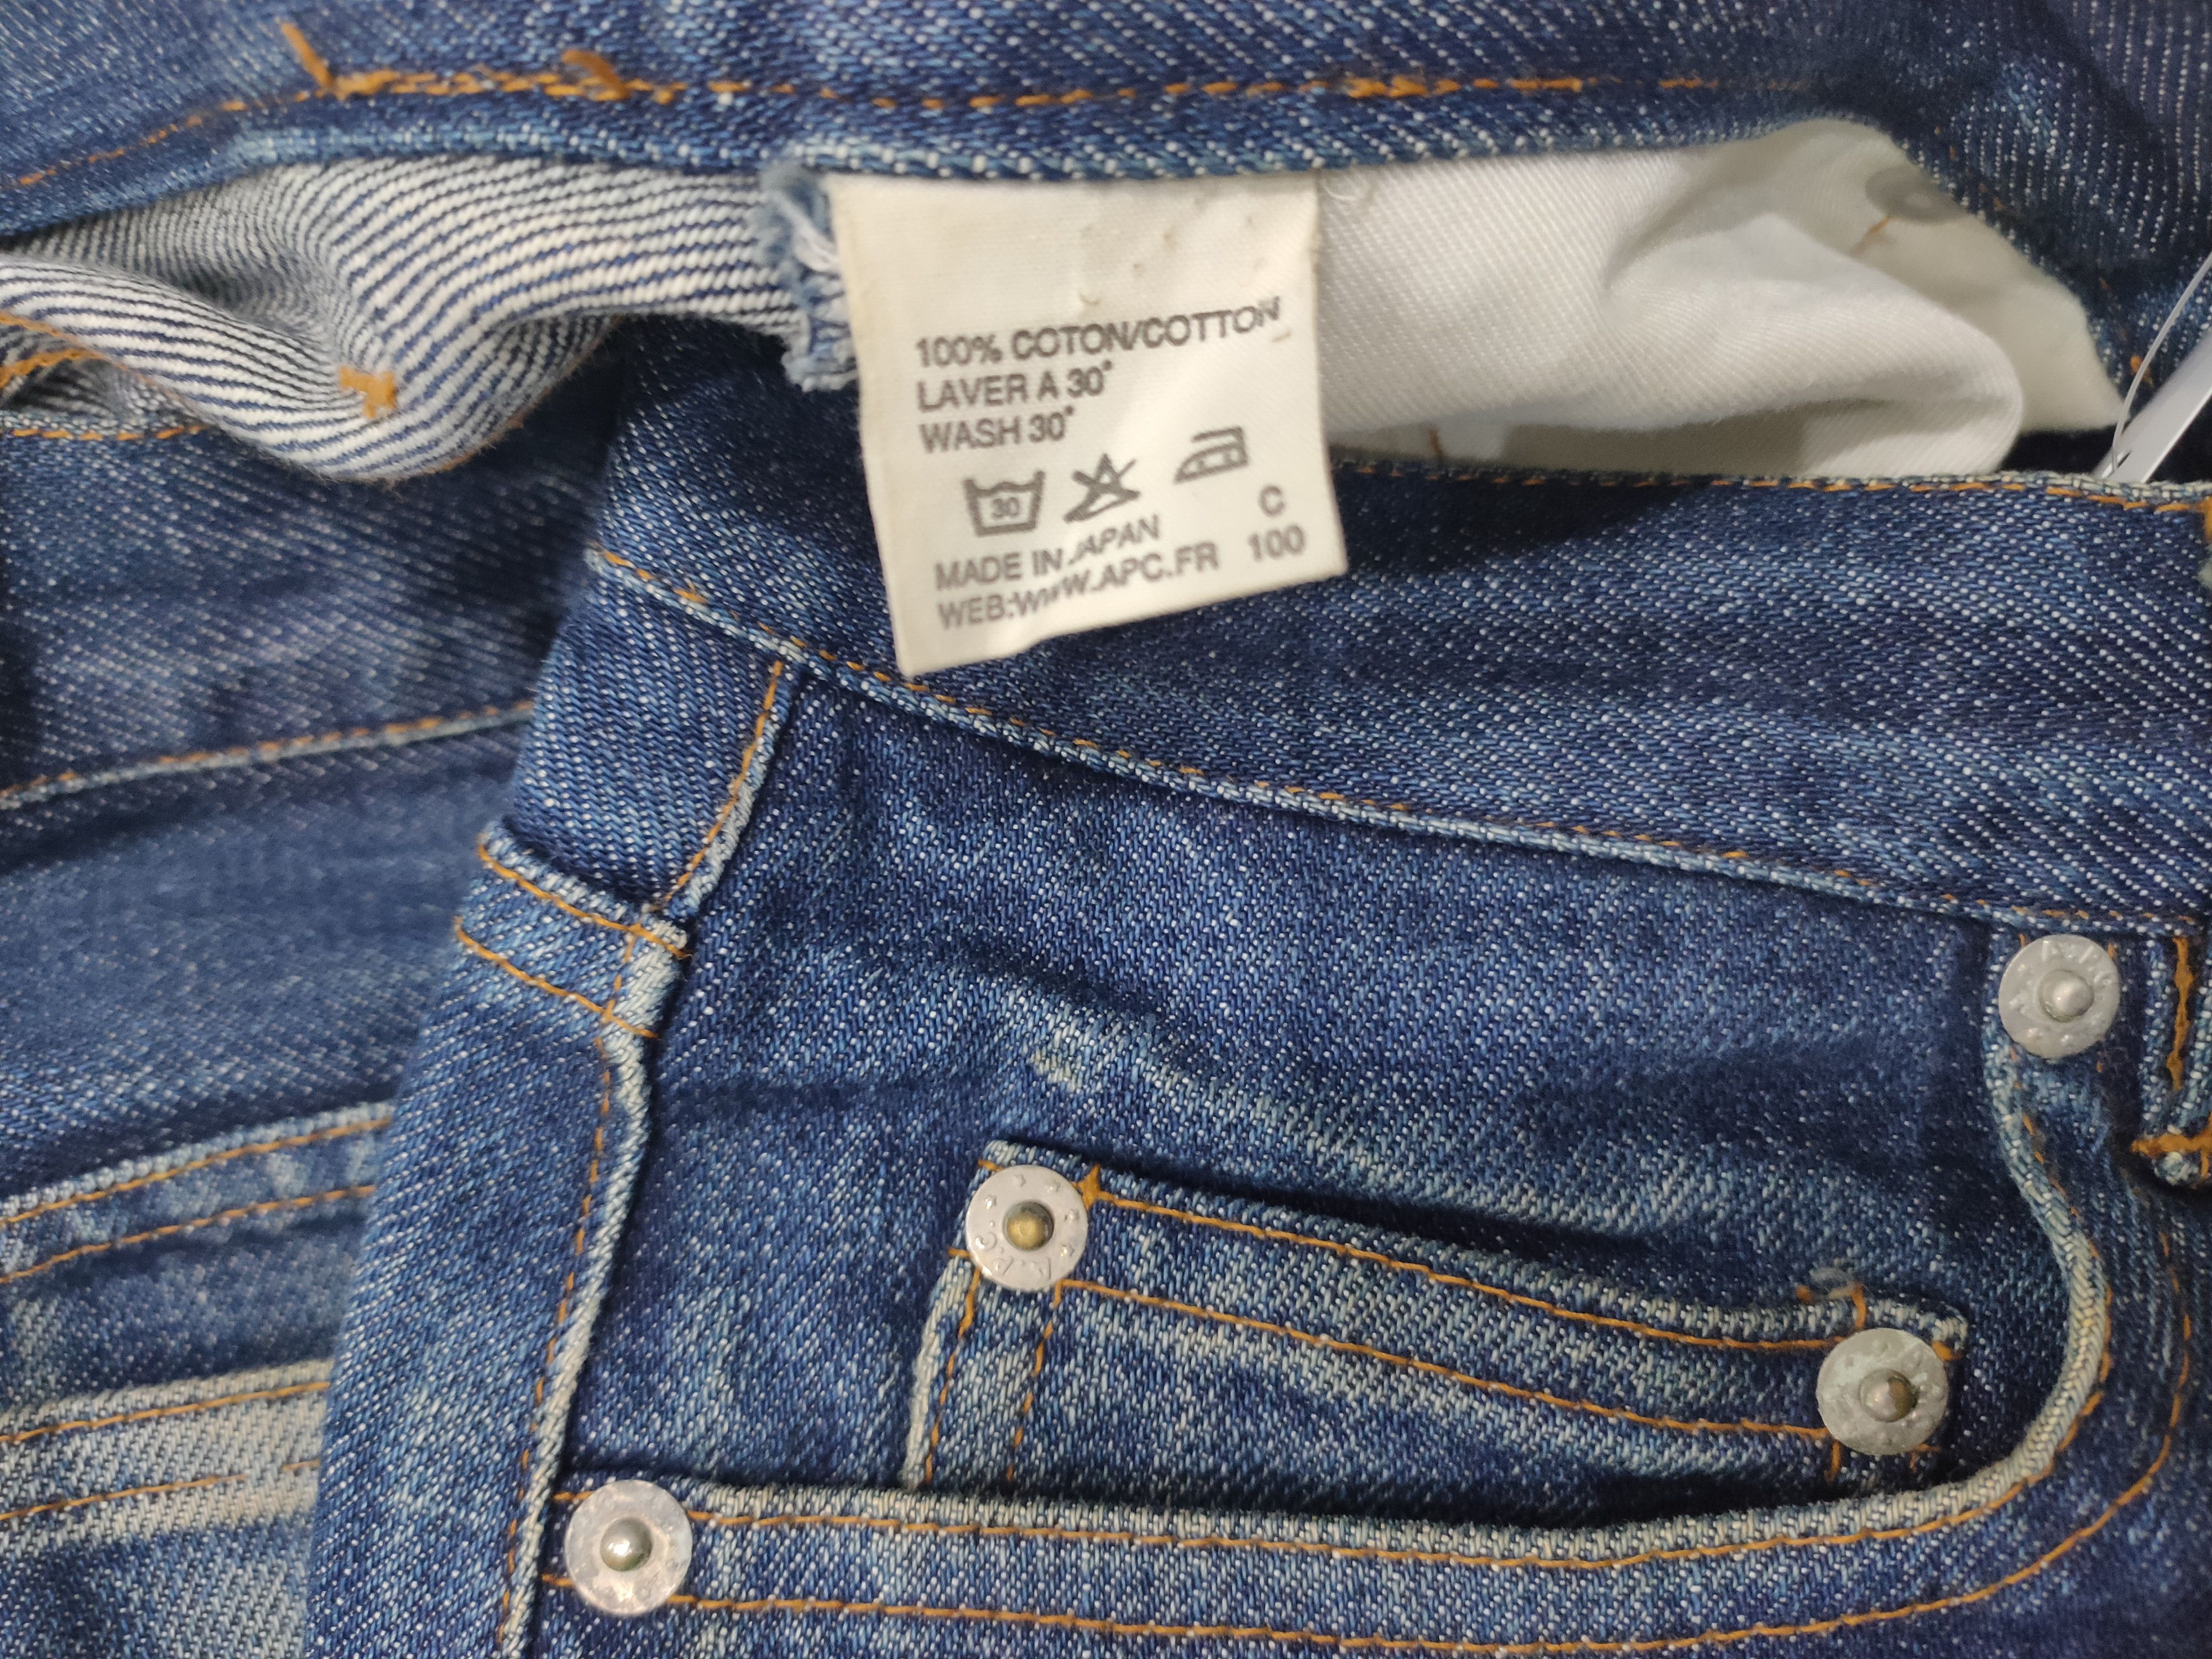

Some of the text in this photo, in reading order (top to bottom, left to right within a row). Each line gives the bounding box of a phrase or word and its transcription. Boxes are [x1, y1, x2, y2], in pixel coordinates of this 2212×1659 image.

[916, 295, 1280, 367] 100% COTON/COTTON
[917, 372, 1029, 413] LAVER
[1037, 369, 1059, 401] A
[919, 416, 1021, 453] WASH
[990, 497, 1020, 519] 30
[1258, 484, 1285, 517] C
[935, 513, 1160, 591] MADE IN JAPAN
[1248, 523, 1306, 561] 100
